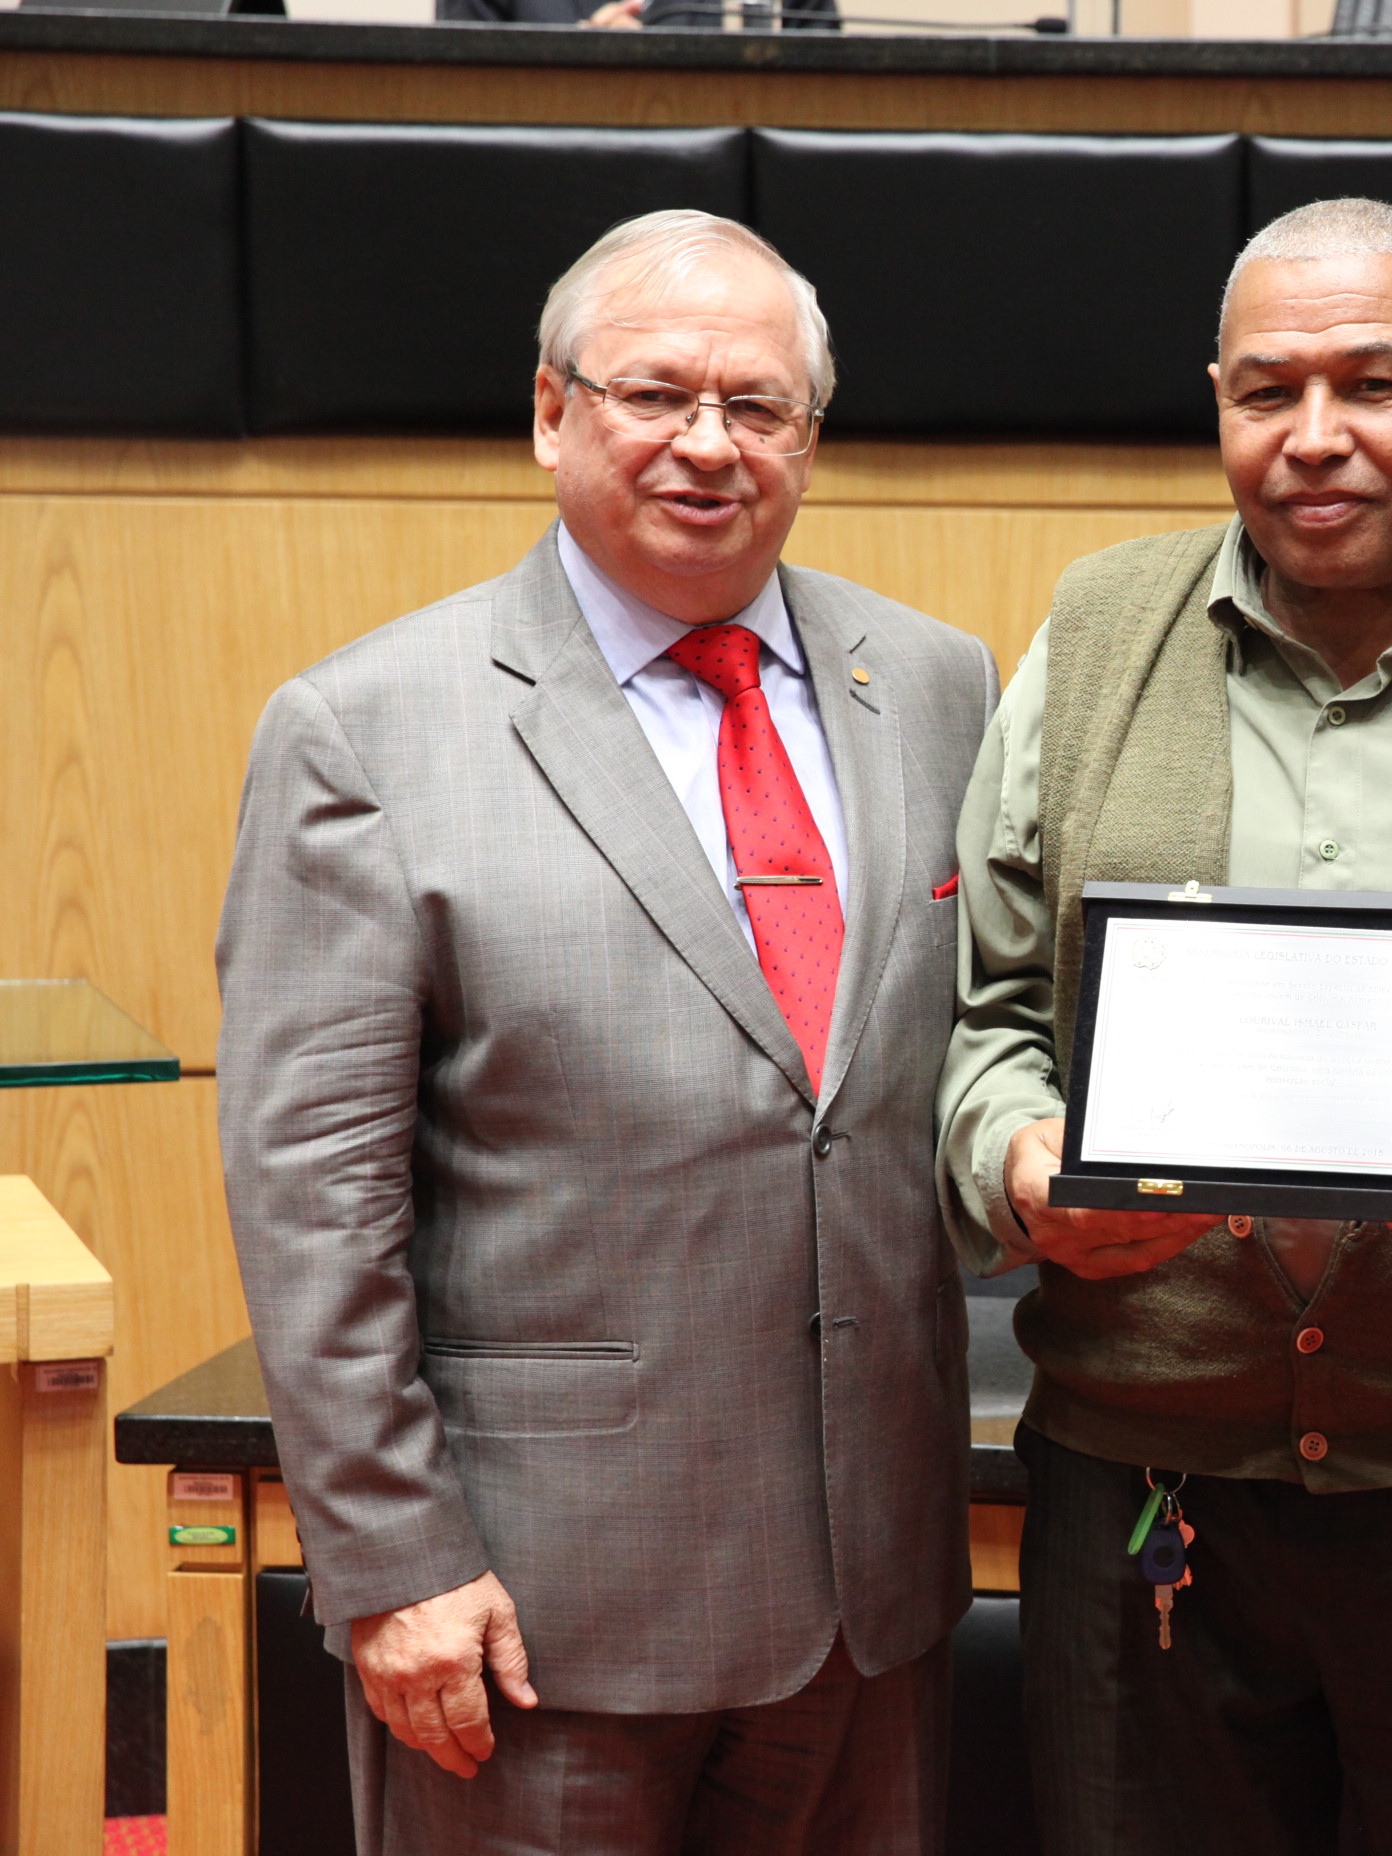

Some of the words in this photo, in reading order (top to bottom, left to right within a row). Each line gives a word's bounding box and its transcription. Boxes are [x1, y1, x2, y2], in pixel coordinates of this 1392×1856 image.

[1254, 951, 1321, 962] LEGISLATIVA
[1325, 954, 1340, 963] DO
[1345, 955, 1388, 966] ESTADO
[1239, 1015, 1290, 1026] LOURIVAL
[1293, 1017, 1330, 1028] ISMAEL
[1335, 1019, 1376, 1030] GASPAR
[1280, 1143, 1295, 1152] 06
[1296, 1144, 1310, 1153] DE
[1311, 1144, 1345, 1155] AGOSTO
[1347, 1146, 1359, 1156] DE
